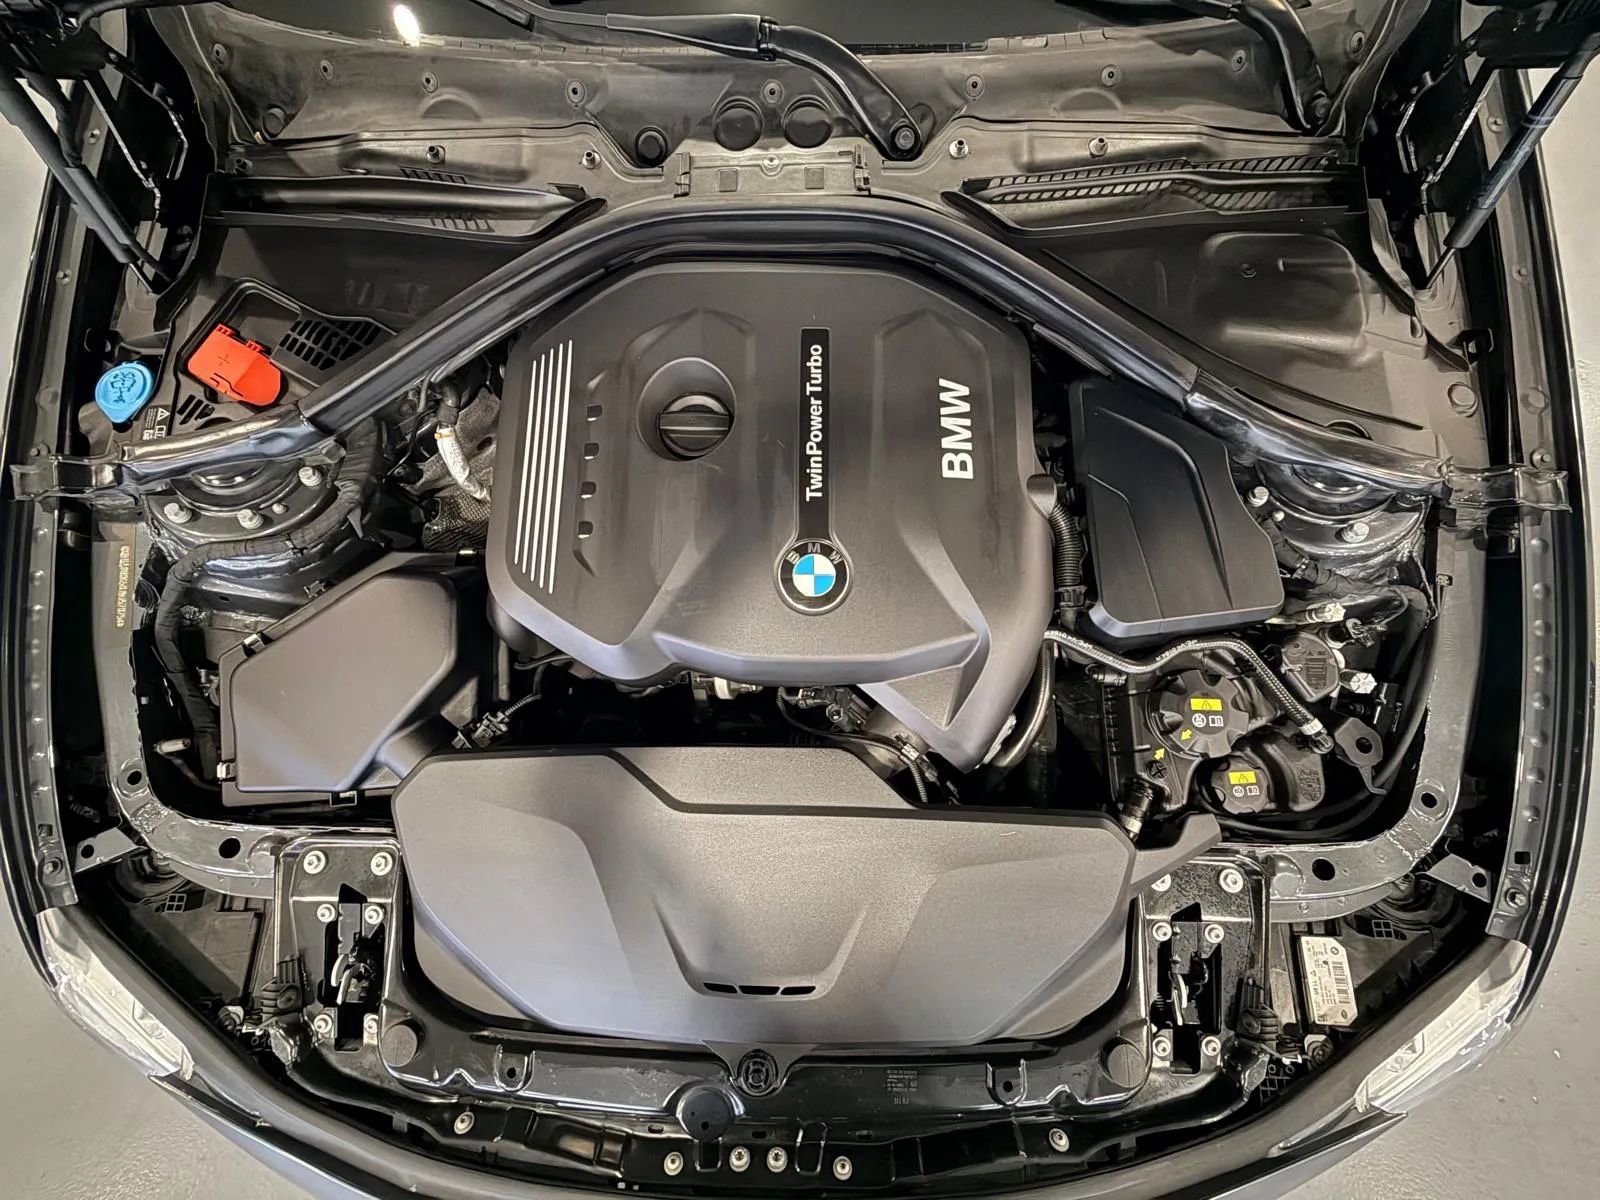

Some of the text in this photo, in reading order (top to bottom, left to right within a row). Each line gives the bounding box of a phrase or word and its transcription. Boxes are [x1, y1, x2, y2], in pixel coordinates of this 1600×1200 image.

[806, 344, 823, 502] TwinPower Turbo
[938, 378, 974, 480] BMW
[786, 543, 841, 565] BMW
